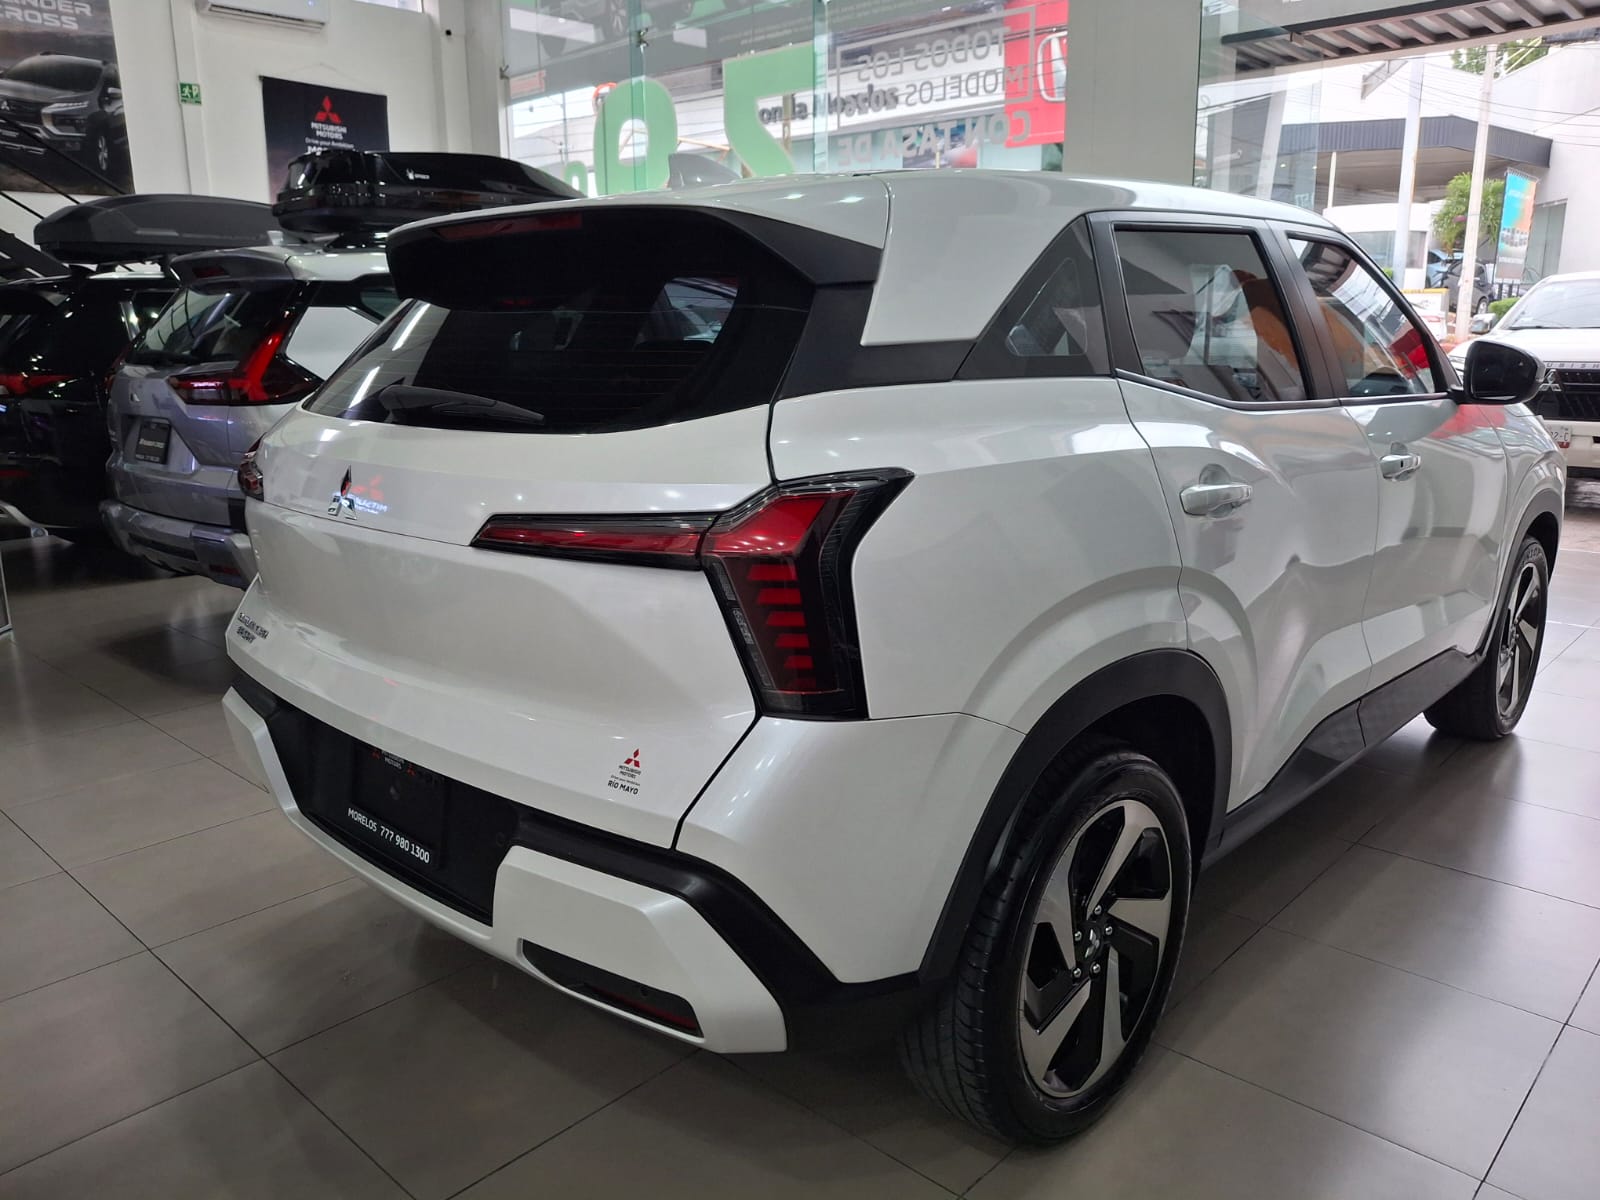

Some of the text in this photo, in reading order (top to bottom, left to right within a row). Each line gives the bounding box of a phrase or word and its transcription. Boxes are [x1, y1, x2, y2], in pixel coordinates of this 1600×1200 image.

[620, 784, 639, 795] MAYO
[348, 808, 430, 863] MORELOS 777 980 1300
